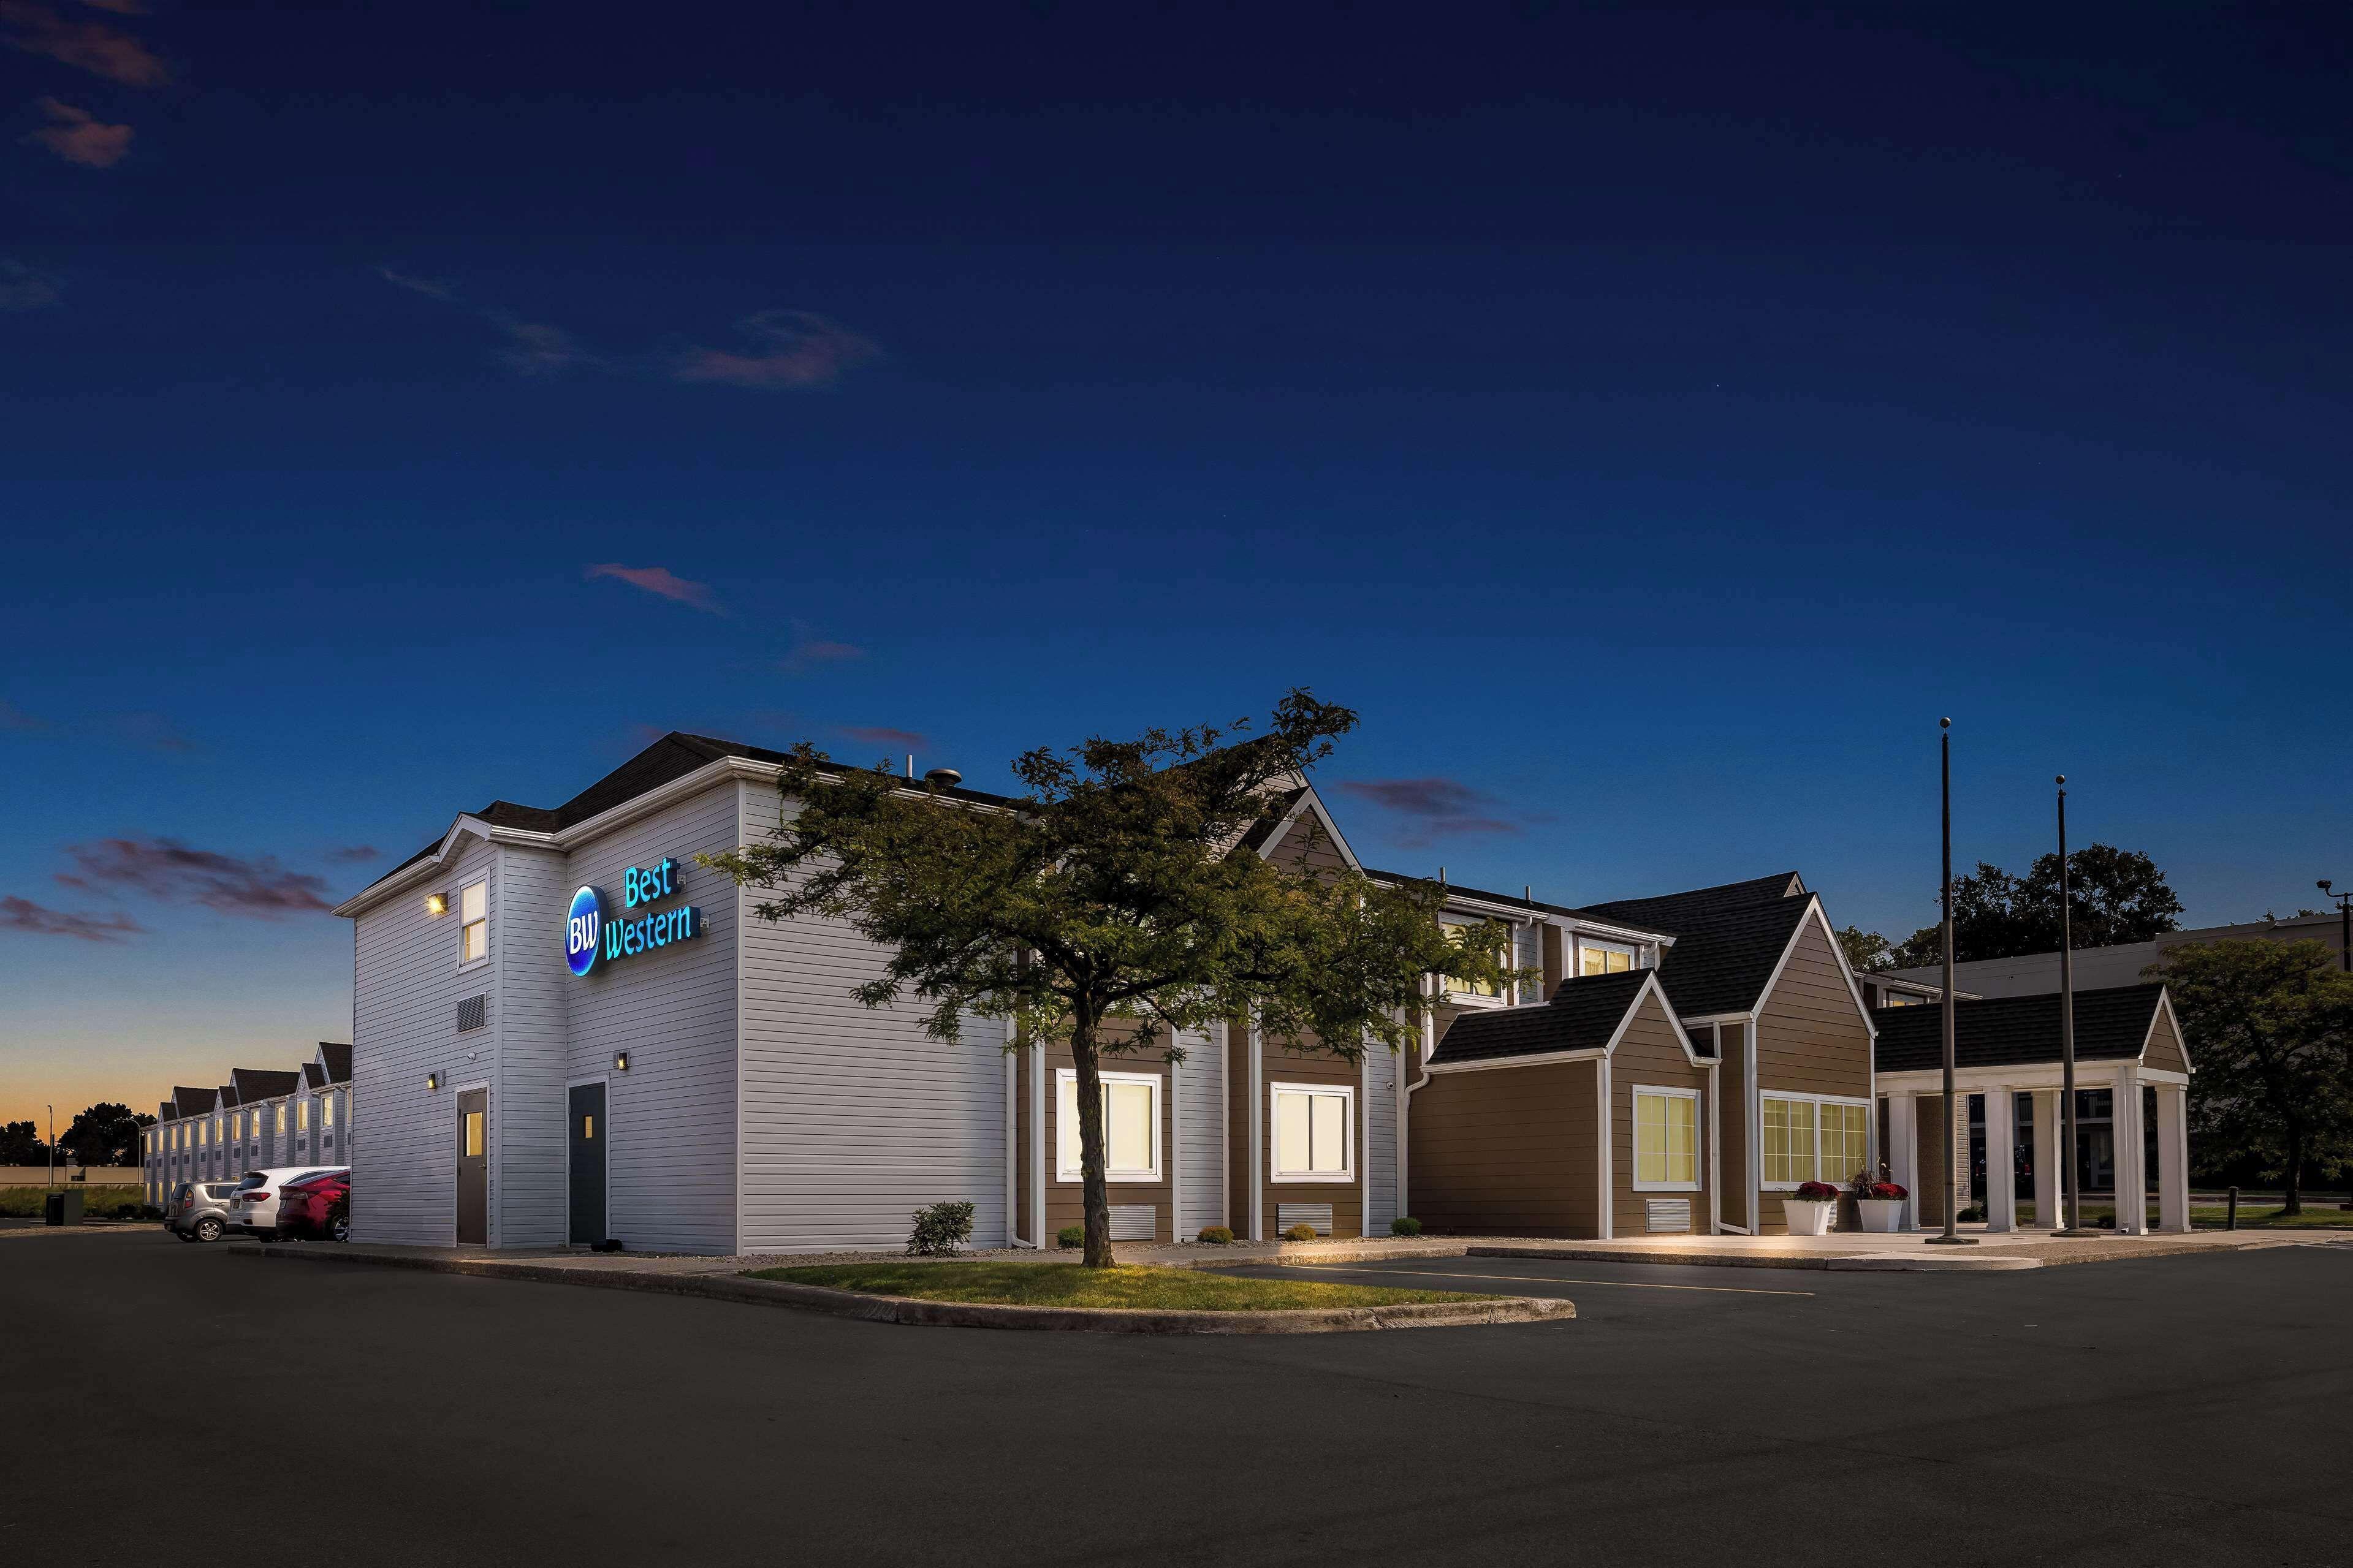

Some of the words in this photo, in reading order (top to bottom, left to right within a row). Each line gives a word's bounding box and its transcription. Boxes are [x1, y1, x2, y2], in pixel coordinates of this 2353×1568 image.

[625, 857, 671, 908] Best
[569, 911, 598, 955] BW
[606, 906, 691, 961] Western
